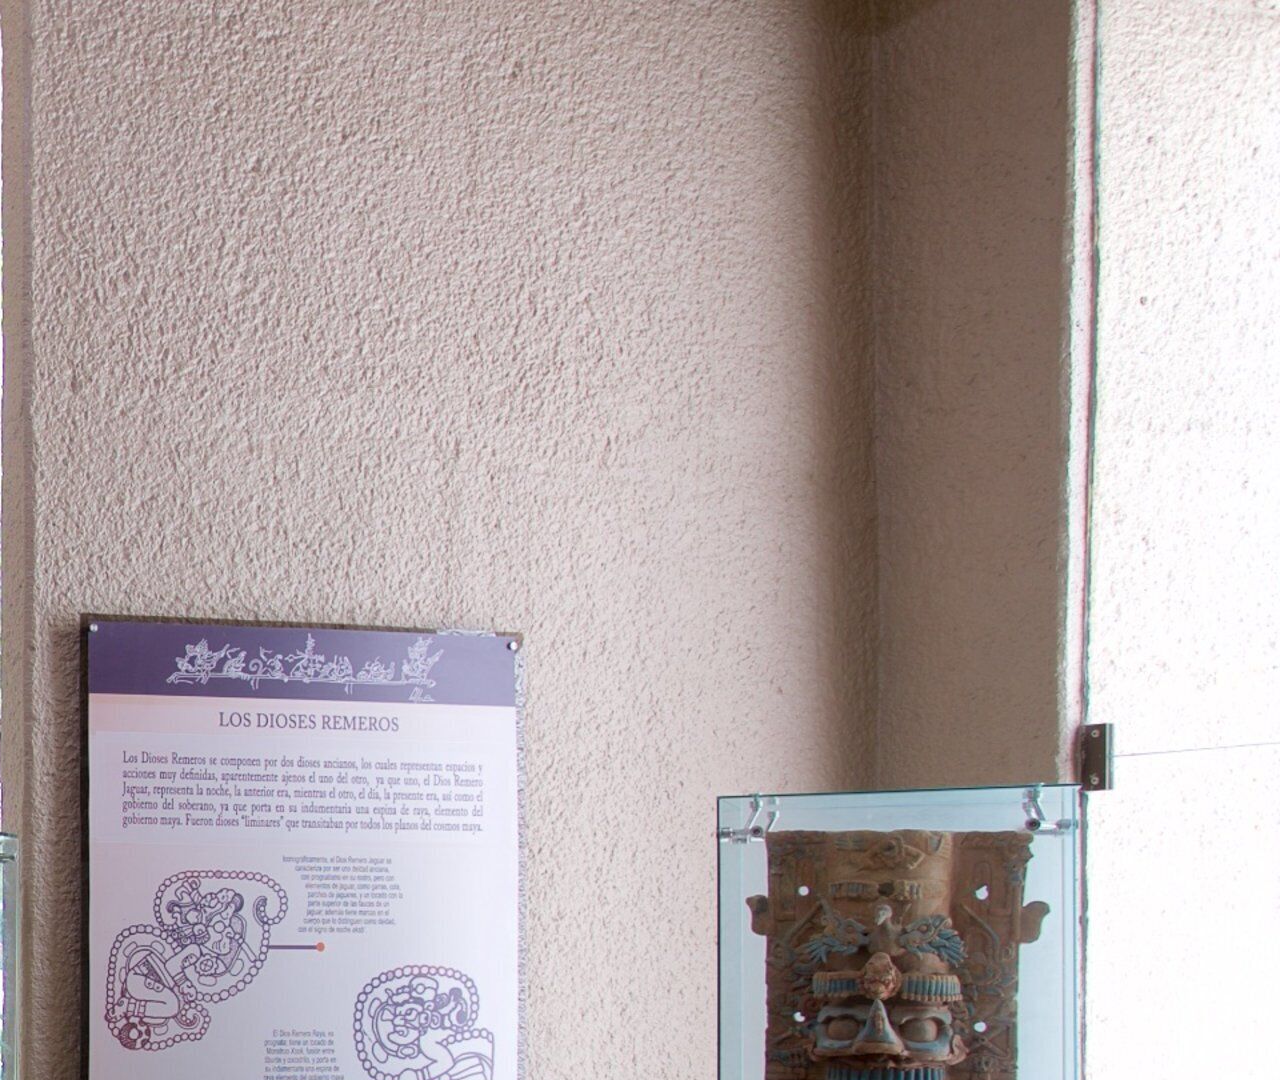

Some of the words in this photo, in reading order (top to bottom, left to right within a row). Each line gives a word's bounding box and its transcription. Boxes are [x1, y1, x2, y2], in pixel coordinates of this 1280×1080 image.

[219, 712, 252, 727] LOS
[256, 712, 317, 729] DIOSES
[321, 714, 399, 731] REMEROS
[122, 751, 138, 764] Los
[142, 751, 168, 764] Dioses
[171, 752, 206, 765] Remeros
[209, 757, 217, 765] se
[220, 757, 261, 770] componen
[264, 758, 277, 771] por
[281, 754, 294, 767] dos
[297, 755, 321, 768] dioses
[323, 755, 358, 772] ancianos,
[361, 756, 372, 769] los
[375, 756, 398, 769] cuales
[400, 759, 442, 774] representan
[445, 758, 475, 775] espacios
[478, 762, 483, 776] y
[122, 767, 156, 780] acciones
[159, 771, 177, 785] muy
[179, 768, 218, 784] definidas,
[221, 771, 278, 786] aparentemente
[281, 770, 306, 787] ajenos
[309, 771, 316, 783] el
[318, 775, 334, 784] uno
[336, 771, 348, 784] del
[351, 774, 369, 788] otro,
[375, 776, 384, 789] ya
[387, 776, 401, 790] que
[404, 777, 421, 789] uno,
[423, 773, 430, 786] el
[434, 774, 451, 786] Dios
[454, 774, 483, 787] Remero
[122, 782, 151, 799] Jaguar,
[153, 785, 195, 799] representa
[196, 783, 204, 796] la
[206, 784, 232, 799] noche,
[234, 784, 241, 796] la
[244, 785, 274, 797] anterior
[276, 789, 291, 801] era,
[294, 785, 326, 798] mientras
[329, 786, 336, 799] el
[338, 788, 356, 802] otro,
[358, 787, 365, 799] el
[367, 787, 382, 803] día,
[384, 787, 391, 800] la
[393, 790, 424, 804] presente
[426, 792, 439, 804] era,
[442, 789, 452, 801] así
[454, 793, 474, 802] como
[478, 789, 483, 802] el
[122, 797, 158, 814] gobierno
[162, 798, 174, 810] del
[178, 798, 216, 814] soberano,
[220, 803, 229, 816] ya
[232, 803, 247, 816] que
[251, 802, 271, 817] porta
[275, 804, 285, 813] en
[288, 804, 297, 813] su
[301, 801, 352, 814] indumentaria
[355, 806, 369, 814] una
[372, 802, 397, 819] espina
[400, 803, 409, 815] de
[413, 807, 431, 820] raya,
[434, 803, 468, 816] elemento
[471, 804, 483, 817] del
[122, 812, 158, 829] gobierno
[160, 816, 183, 830] maya.
[185, 813, 214, 826] Fueron
[215, 814, 239, 827] dioses
[240, 814, 284, 827] “liminares”
[285, 819, 300, 832] que
[301, 816, 343, 829] transitaban
[345, 820, 358, 833] por
[360, 817, 381, 829] todos
[382, 817, 393, 830] los
[395, 817, 418, 834] planos
[420, 818, 431, 830] del
[433, 822, 460, 831] cosmos
[462, 822, 483, 836] maya.
